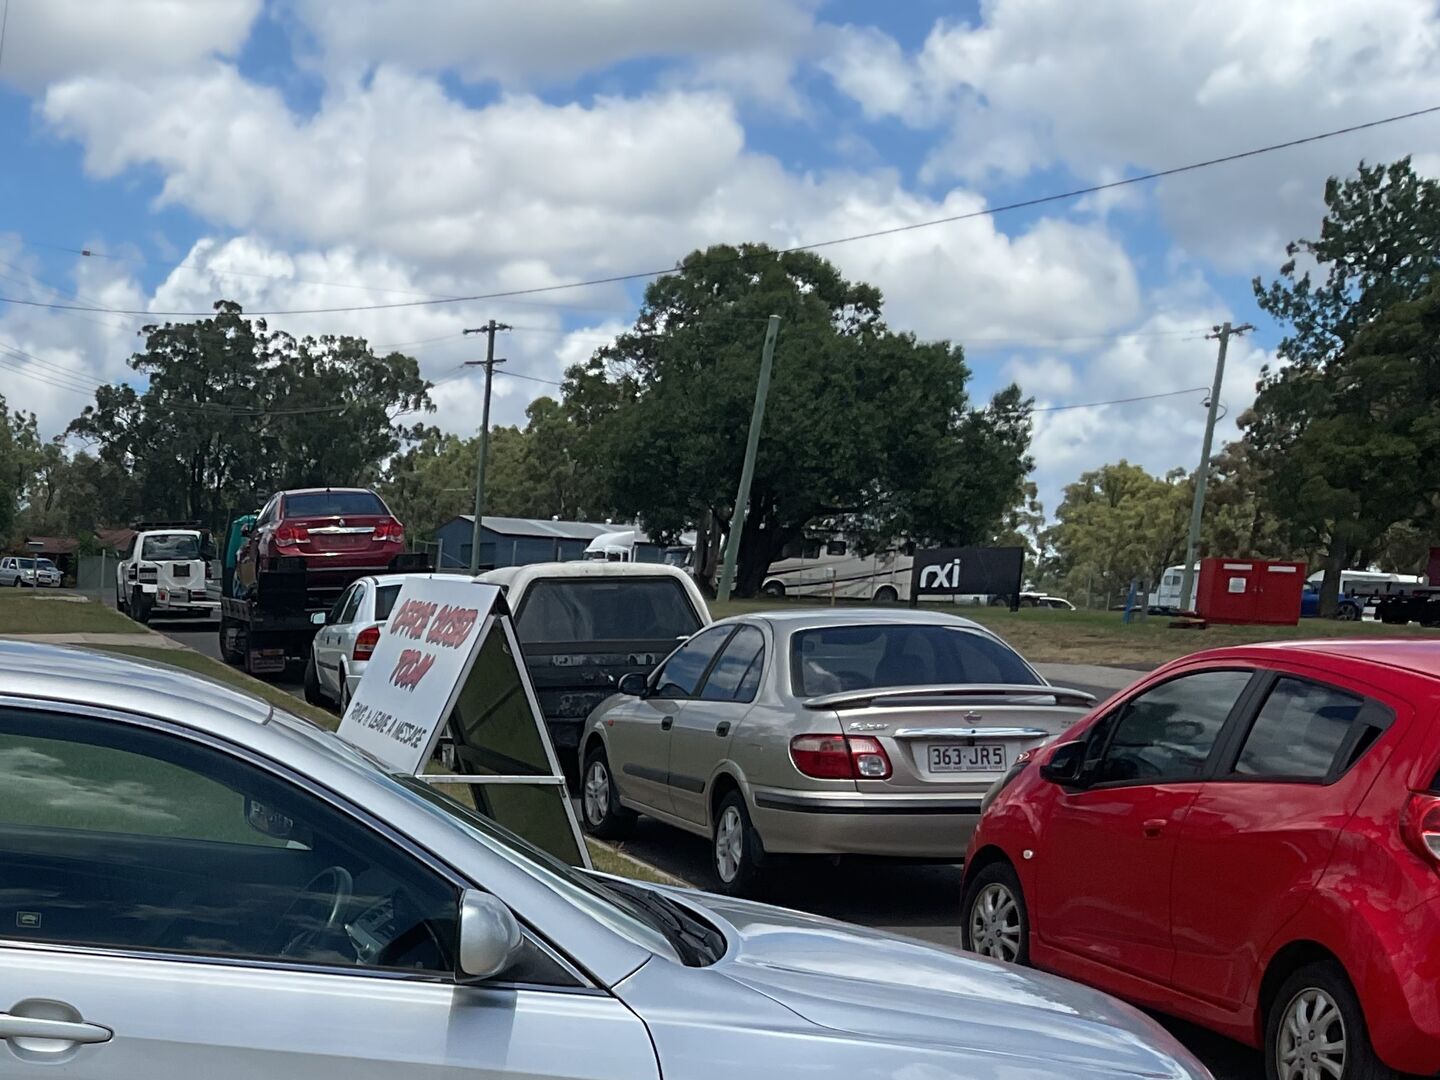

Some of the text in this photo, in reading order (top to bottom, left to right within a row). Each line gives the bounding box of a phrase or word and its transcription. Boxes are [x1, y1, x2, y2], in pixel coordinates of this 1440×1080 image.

[919, 558, 961, 588] rxi
[390, 598, 479, 650] OFFICE CLOSED
[368, 710, 392, 733] LEAVE
[385, 717, 398, 736] A
[391, 720, 427, 748] MESSAGE
